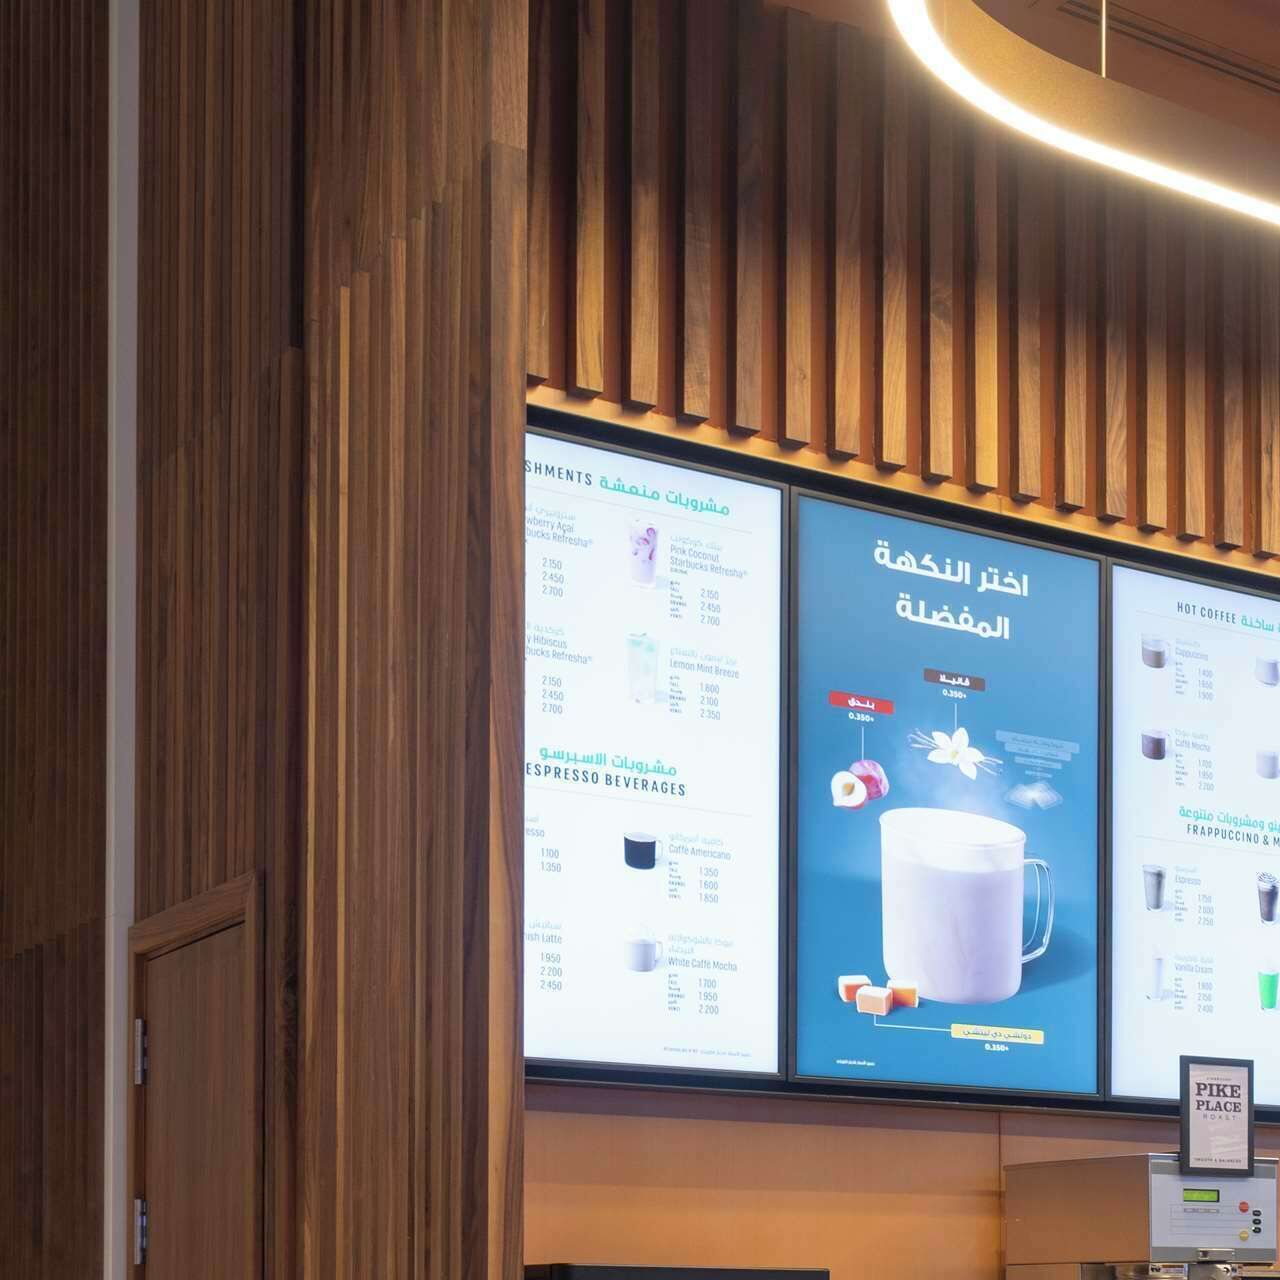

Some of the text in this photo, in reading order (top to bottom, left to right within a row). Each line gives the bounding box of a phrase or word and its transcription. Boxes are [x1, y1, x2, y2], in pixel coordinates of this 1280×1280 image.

[599, 475, 730, 516] مشروبات منعشة
[874, 539, 1029, 597] اختر النكهة
[895, 592, 1010, 640] المفضلة
[1177, 601, 1236, 624] HOT COFFEE
[670, 659, 695, 672] Lemon
[697, 663, 713, 675] Mint
[848, 697, 875, 710] بندق
[611, 754, 677, 777] مشروبات
[526, 762, 686, 796] ESPRESSO BEVERAGES
[1187, 823, 1259, 845] FRAPPUCCINO
[1262, 835, 1270, 846] &
[1196, 1083, 1240, 1098] PIKE
[1196, 1100, 1241, 1112] PLACE
